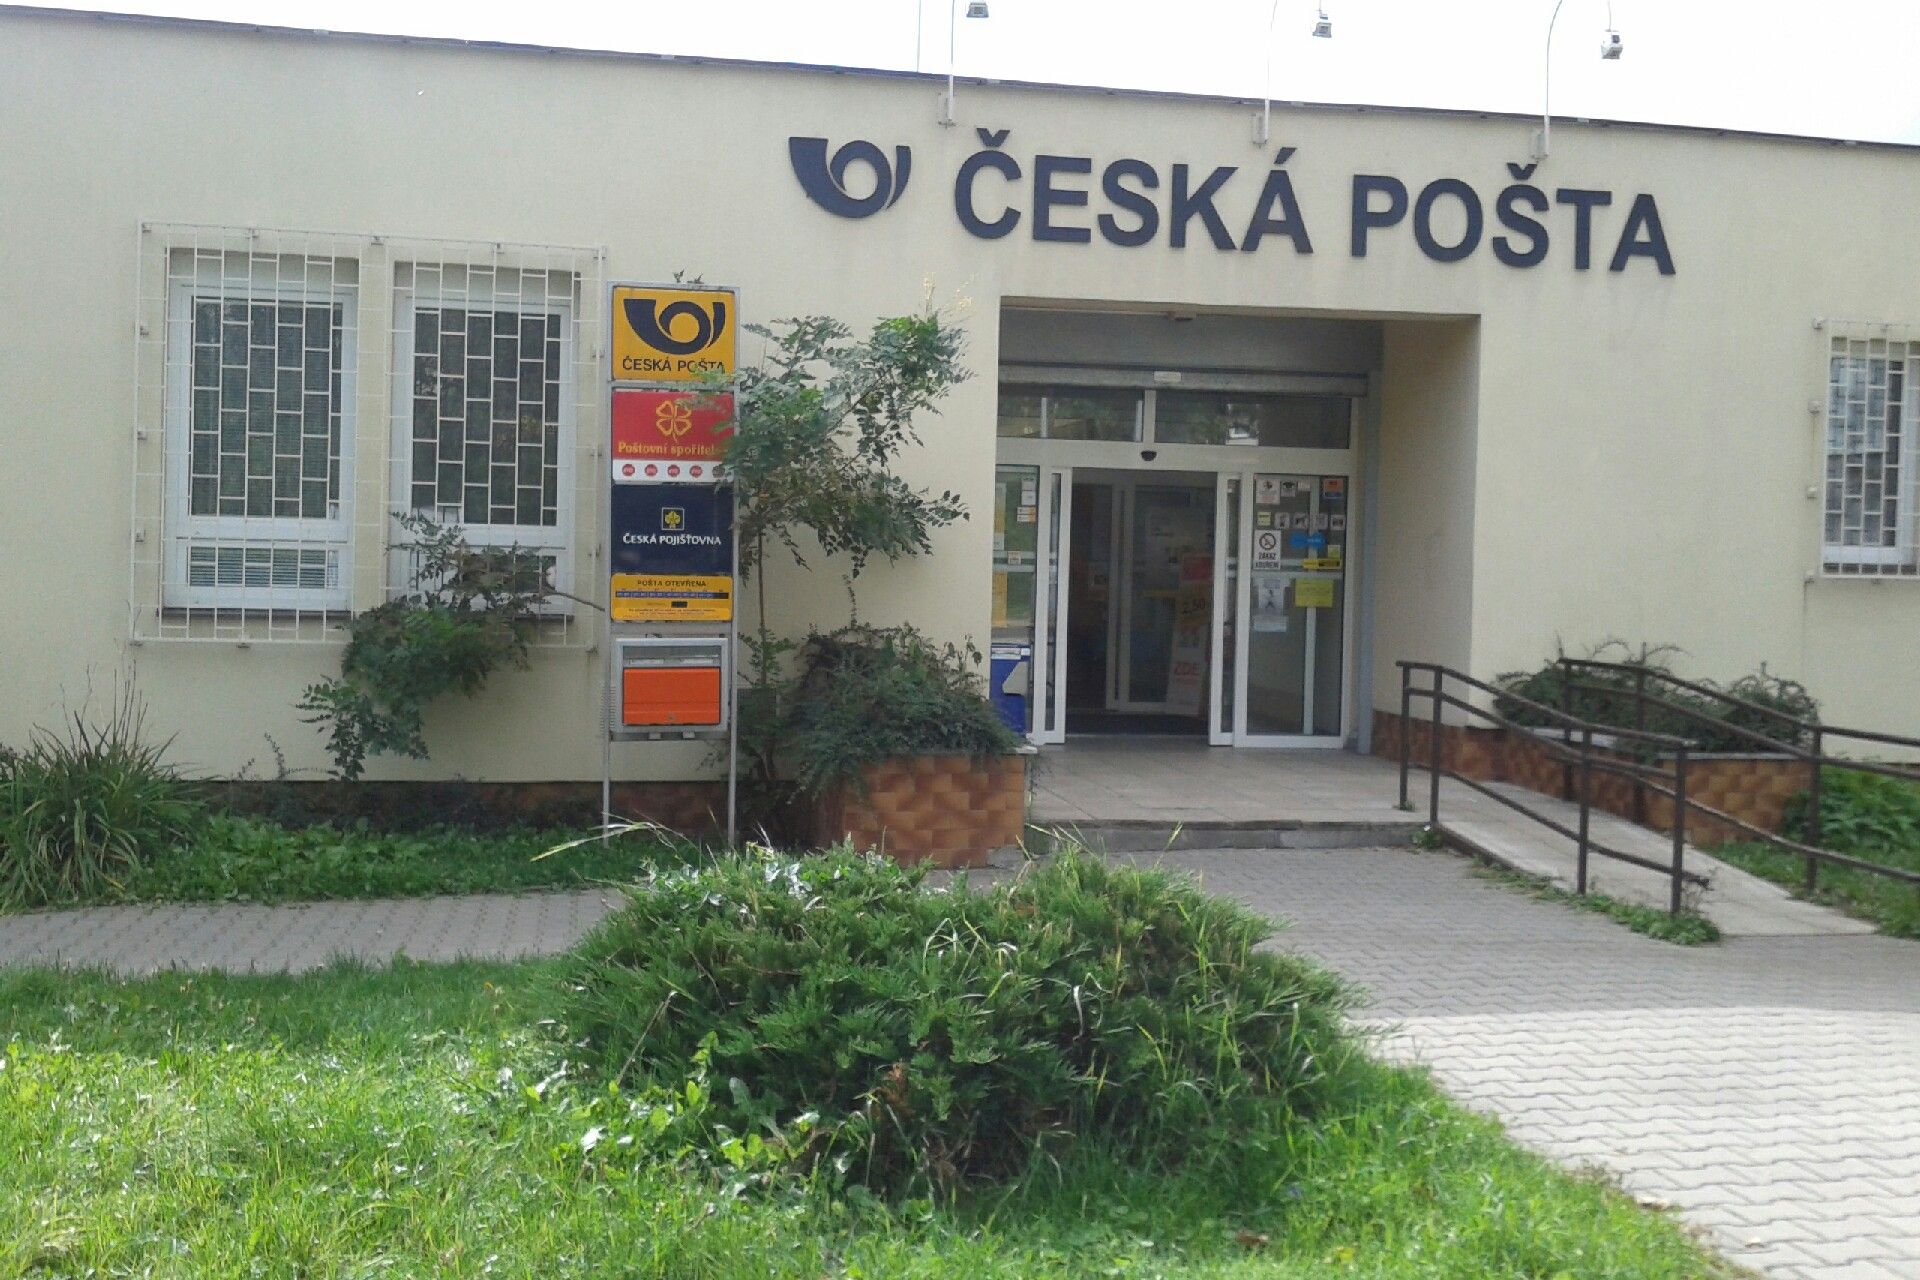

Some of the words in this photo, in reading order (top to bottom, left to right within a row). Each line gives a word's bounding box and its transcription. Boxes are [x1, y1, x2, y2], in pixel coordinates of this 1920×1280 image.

[954, 127, 1313, 254] ČESKÁ
[1351, 162, 1677, 276] POŠTA
[622, 355, 672, 372] ČESKÁ
[622, 532, 657, 545] ČESKÁ
